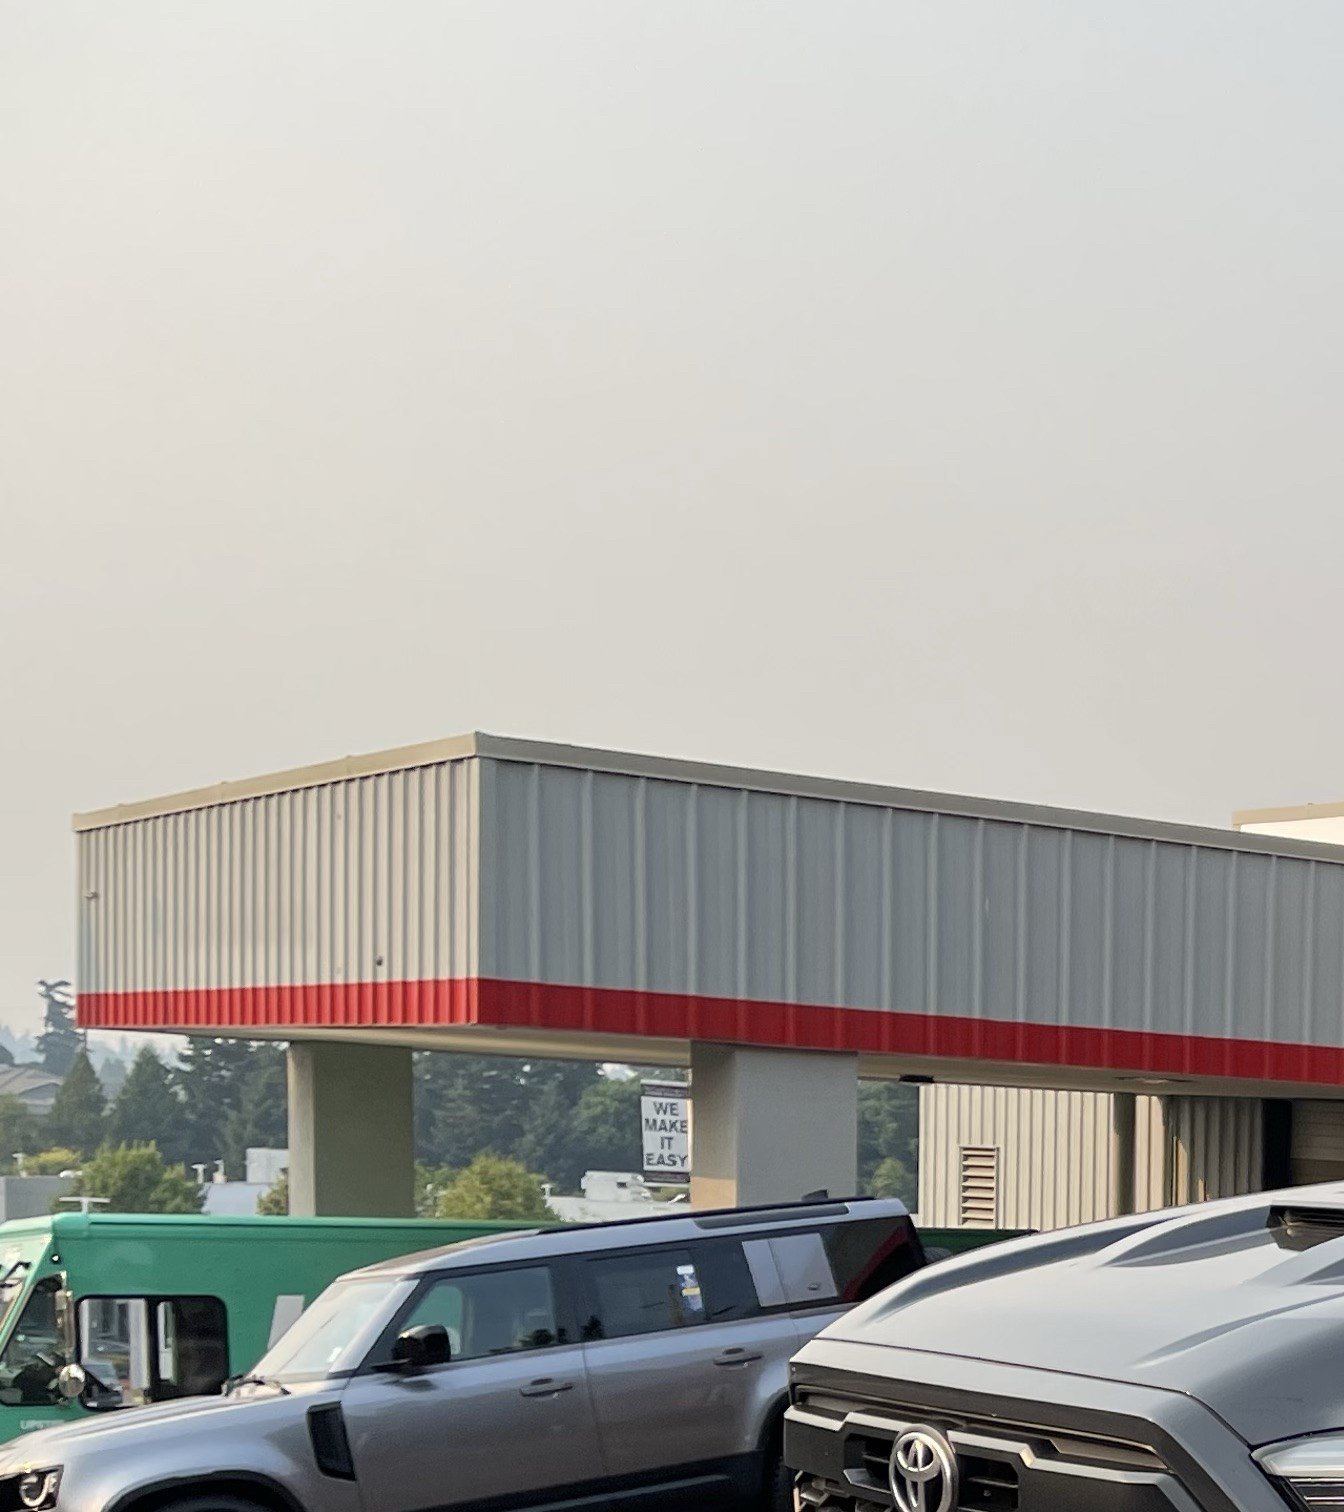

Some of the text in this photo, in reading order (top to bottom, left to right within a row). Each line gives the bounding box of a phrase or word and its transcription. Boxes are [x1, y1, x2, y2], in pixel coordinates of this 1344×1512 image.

[653, 1101, 679, 1116] WE
[644, 1117, 688, 1134] MAKE
[659, 1136, 674, 1150] IT
[645, 1153, 689, 1168] EASY
